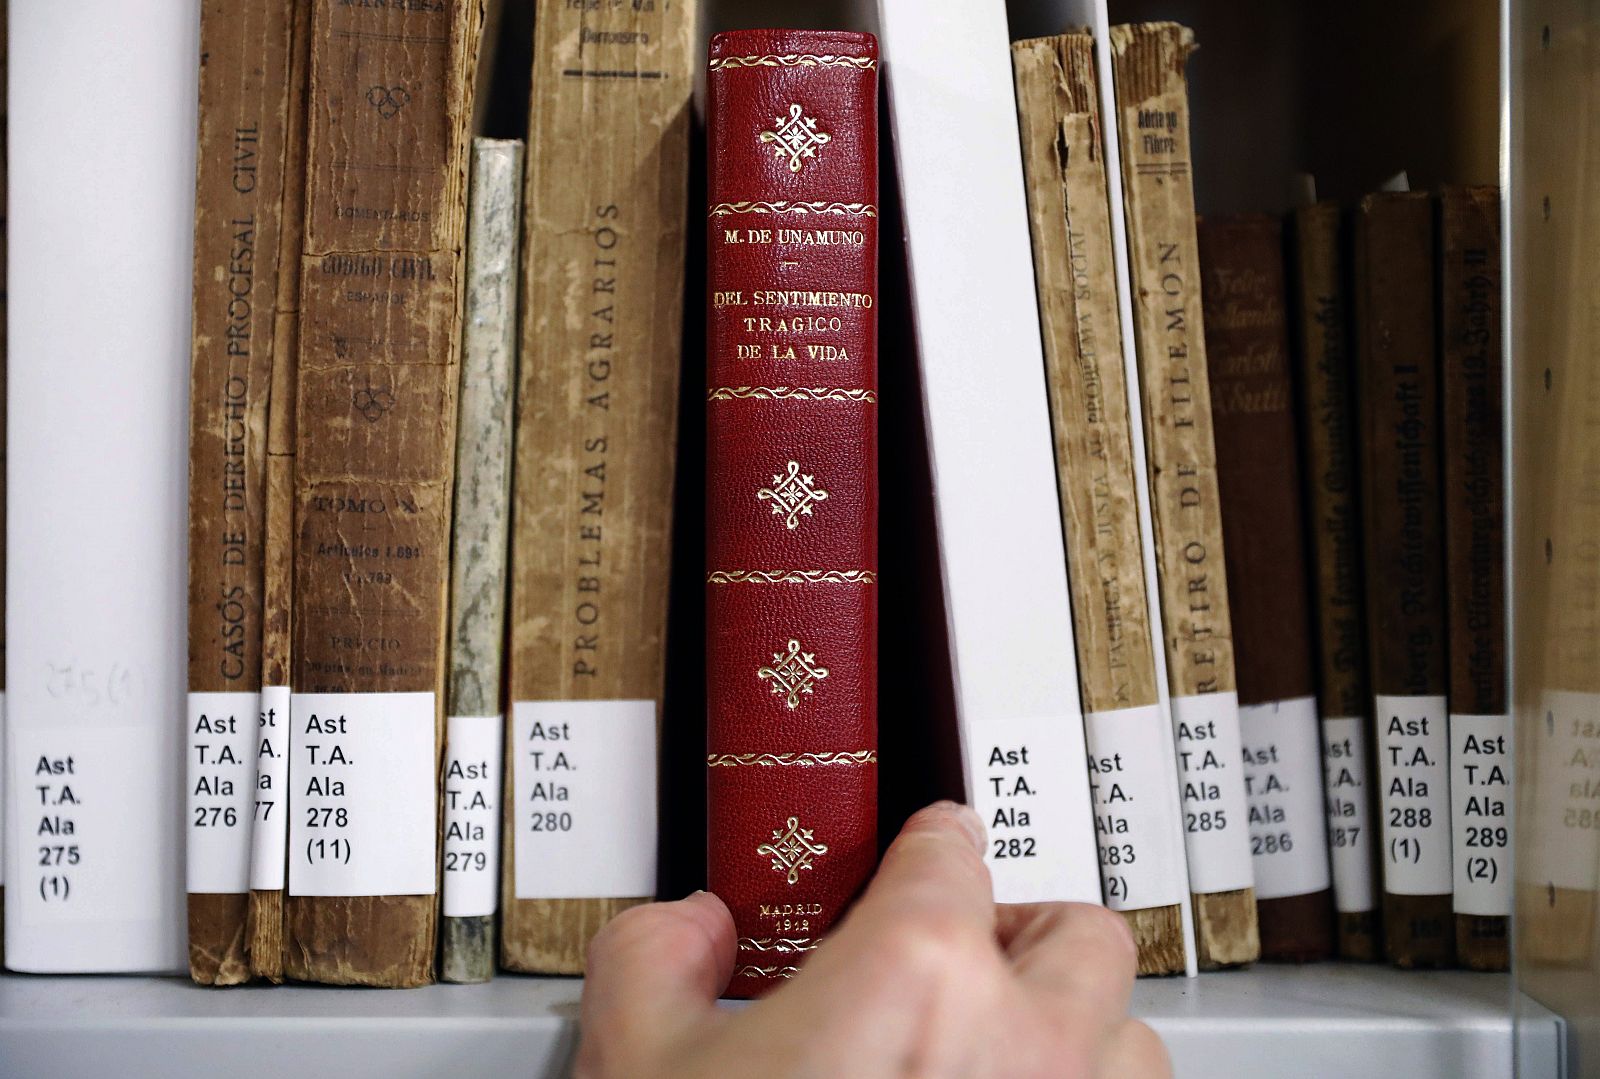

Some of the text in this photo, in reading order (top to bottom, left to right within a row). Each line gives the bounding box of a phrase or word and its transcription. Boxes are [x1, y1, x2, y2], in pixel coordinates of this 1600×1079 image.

[232, 121, 258, 193] CIVIL
[725, 229, 864, 245] M. DE UNAMUNO
[1071, 226, 1092, 300] SOCIAL
[227, 215, 254, 356] PROCESAL
[713, 291, 873, 309] DEL SENTIMIENTO
[743, 317, 842, 332] TRAGICO
[737, 345, 850, 361] DE LA VIDA
[222, 376, 246, 513] DERECHO
[572, 203, 619, 678] PROBLEMAS AGRARIOS
[1157, 240, 1219, 695] RETIRO DE FILEMON
[313, 497, 387, 514] TOMO
[1092, 474, 1115, 537] JUSTA
[222, 532, 245, 566] DE
[330, 636, 401, 651] PRECIO
[194, 714, 237, 735] Ast
[258, 705, 276, 729] st
[304, 713, 347, 735] Ast
[1387, 715, 1430, 737] Ast
[529, 721, 570, 741] Ast
[1176, 720, 1216, 743] Ast
[194, 744, 243, 765] T.A.
[305, 745, 353, 766] T.A.
[1242, 745, 1278, 765] Ast
[1328, 738, 1354, 759] st
[1463, 734, 1506, 755] Ast
[35, 755, 74, 775] Ast
[529, 751, 577, 771] T.A.
[988, 746, 1029, 767] Ast
[1087, 752, 1123, 775] Ast
[1179, 750, 1225, 773] T.A.
[1387, 746, 1436, 767] T.A.
[255, 767, 272, 791] la
[447, 758, 488, 780] Ast
[1331, 767, 1362, 789] .A.
[1463, 764, 1510, 786] T.A.
[36, 784, 81, 806] T.A.
[194, 775, 234, 796] Ala
[305, 776, 345, 797] Ala
[530, 781, 569, 802] Ala
[989, 775, 1037, 798] T.A.
[1182, 781, 1221, 803] Ala
[1245, 773, 1289, 797] T.A.
[1389, 776, 1429, 798] Ala
[252, 799, 275, 823] 77
[446, 789, 493, 811] T.A.
[1464, 795, 1505, 817] Ala
[38, 815, 75, 836] Ala
[194, 806, 237, 828] 276
[306, 807, 348, 828] 278
[531, 811, 573, 832] 280
[991, 807, 1031, 829] Ala
[1185, 810, 1227, 834] 285
[1249, 804, 1285, 826] Ala
[1390, 807, 1432, 829] 288
[446, 821, 484, 842] Ala
[1465, 826, 1508, 848] 289
[306, 838, 351, 865] (11)
[993, 837, 1037, 860] 282
[1250, 832, 1293, 856] 286
[1390, 837, 1421, 865] (1)
[39, 845, 81, 867] 275
[445, 851, 487, 872] 279
[1466, 857, 1498, 884] (2)
[39, 875, 70, 902] (1)
[1106, 876, 1128, 902] 2)
[759, 903, 823, 917] MADRID
